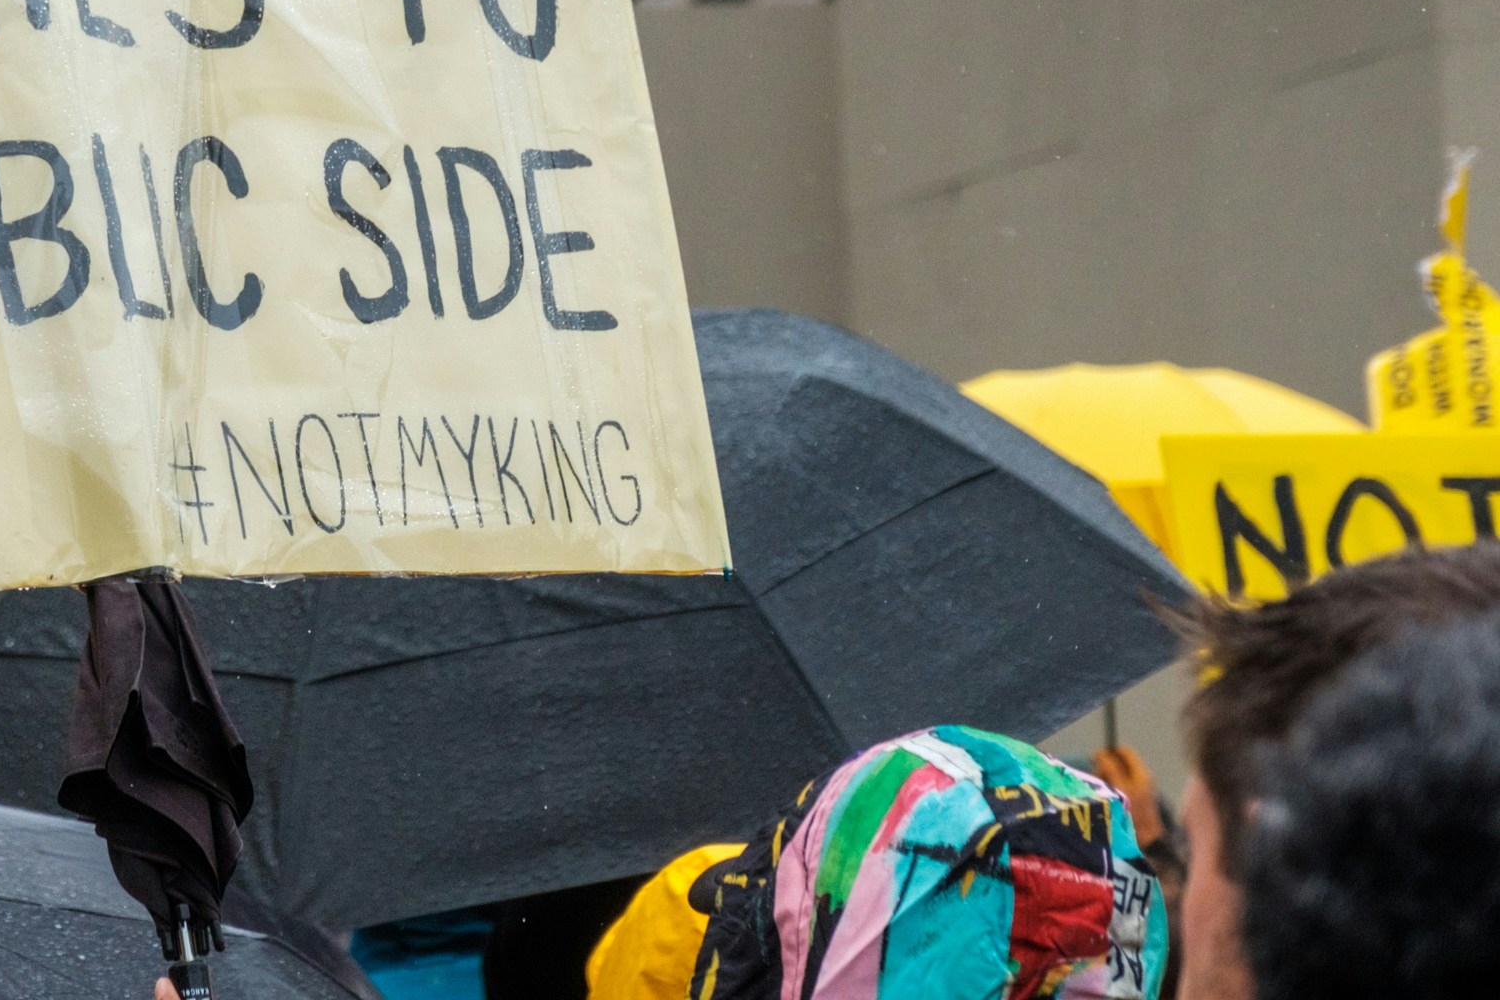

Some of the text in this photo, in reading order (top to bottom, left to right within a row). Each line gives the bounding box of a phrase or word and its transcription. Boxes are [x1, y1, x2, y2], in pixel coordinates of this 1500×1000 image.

[323, 137, 619, 332] SIDE
[168, 412, 642, 546] #NOTMYKING
[1213, 473, 1500, 601] NOT
[181, 986, 211, 997] KANGOL
